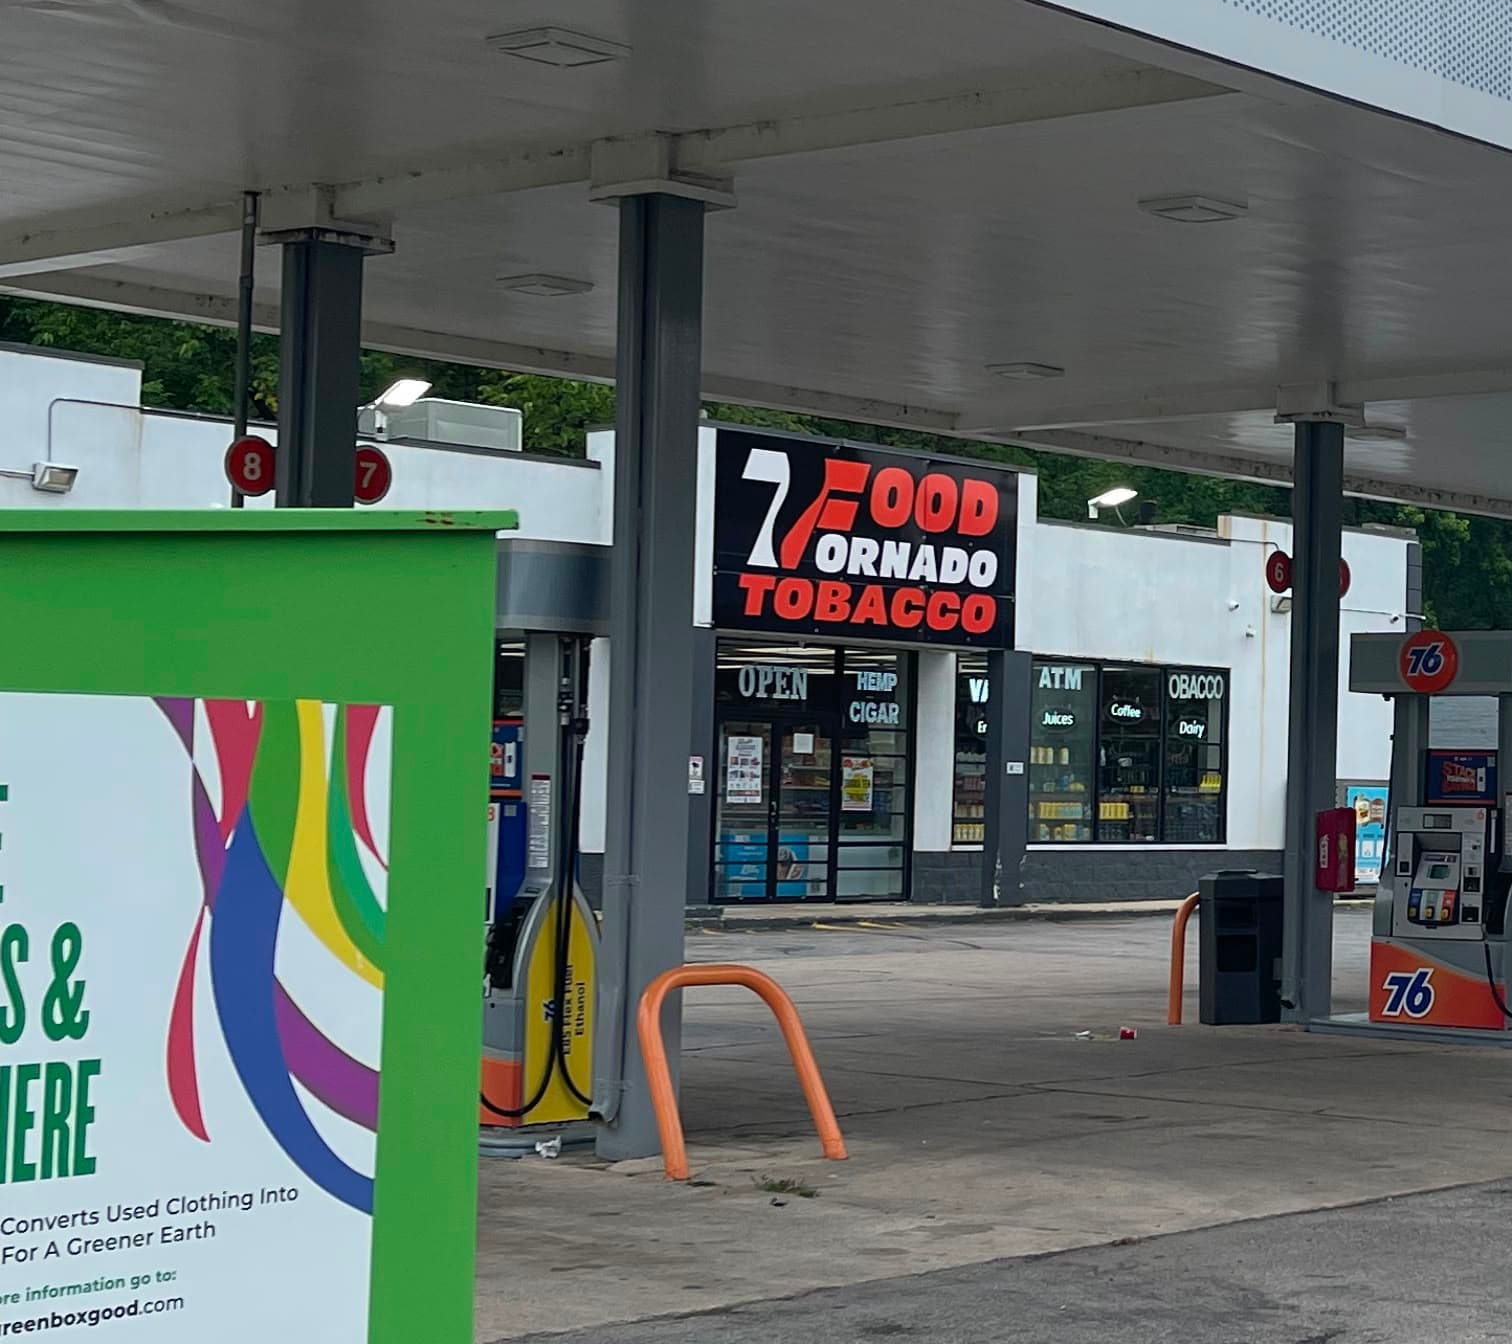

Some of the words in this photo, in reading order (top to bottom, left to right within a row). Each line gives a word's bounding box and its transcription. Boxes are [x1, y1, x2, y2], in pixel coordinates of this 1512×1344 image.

[243, 452, 262, 481] 8
[359, 461, 378, 489] 7
[1274, 562, 1284, 583] 6
[738, 572, 997, 634] TOBACCO
[1407, 642, 1444, 677] 76
[738, 664, 808, 700] OPEN
[856, 671, 898, 692] HEMP
[1039, 666, 1082, 690] ATM
[1168, 674, 1224, 700] OBACCO
[850, 701, 900, 725] CIGAR
[1041, 711, 1075, 726] Juices
[1111, 703, 1142, 719] Coffee
[1179, 720, 1205, 739] Dairy
[41, 921, 91, 1042] &
[1382, 968, 1435, 1018] 76
[574, 982, 586, 1036] Ethanol
[0, 1209, 100, 1236] Converts
[107, 1199, 160, 1223] Used
[166, 1191, 254, 1215] Clothing
[260, 1186, 299, 1205] Into
[1, 1246, 38, 1265] For
[44, 1241, 61, 1260] A
[67, 1231, 154, 1256] Greener
[160, 1221, 216, 1245] Earth
[25, 1277, 126, 1303] information
[130, 1274, 152, 1290] go
[156, 1270, 178, 1284] to:
[0, 1296, 184, 1337] reenboxgood.com
